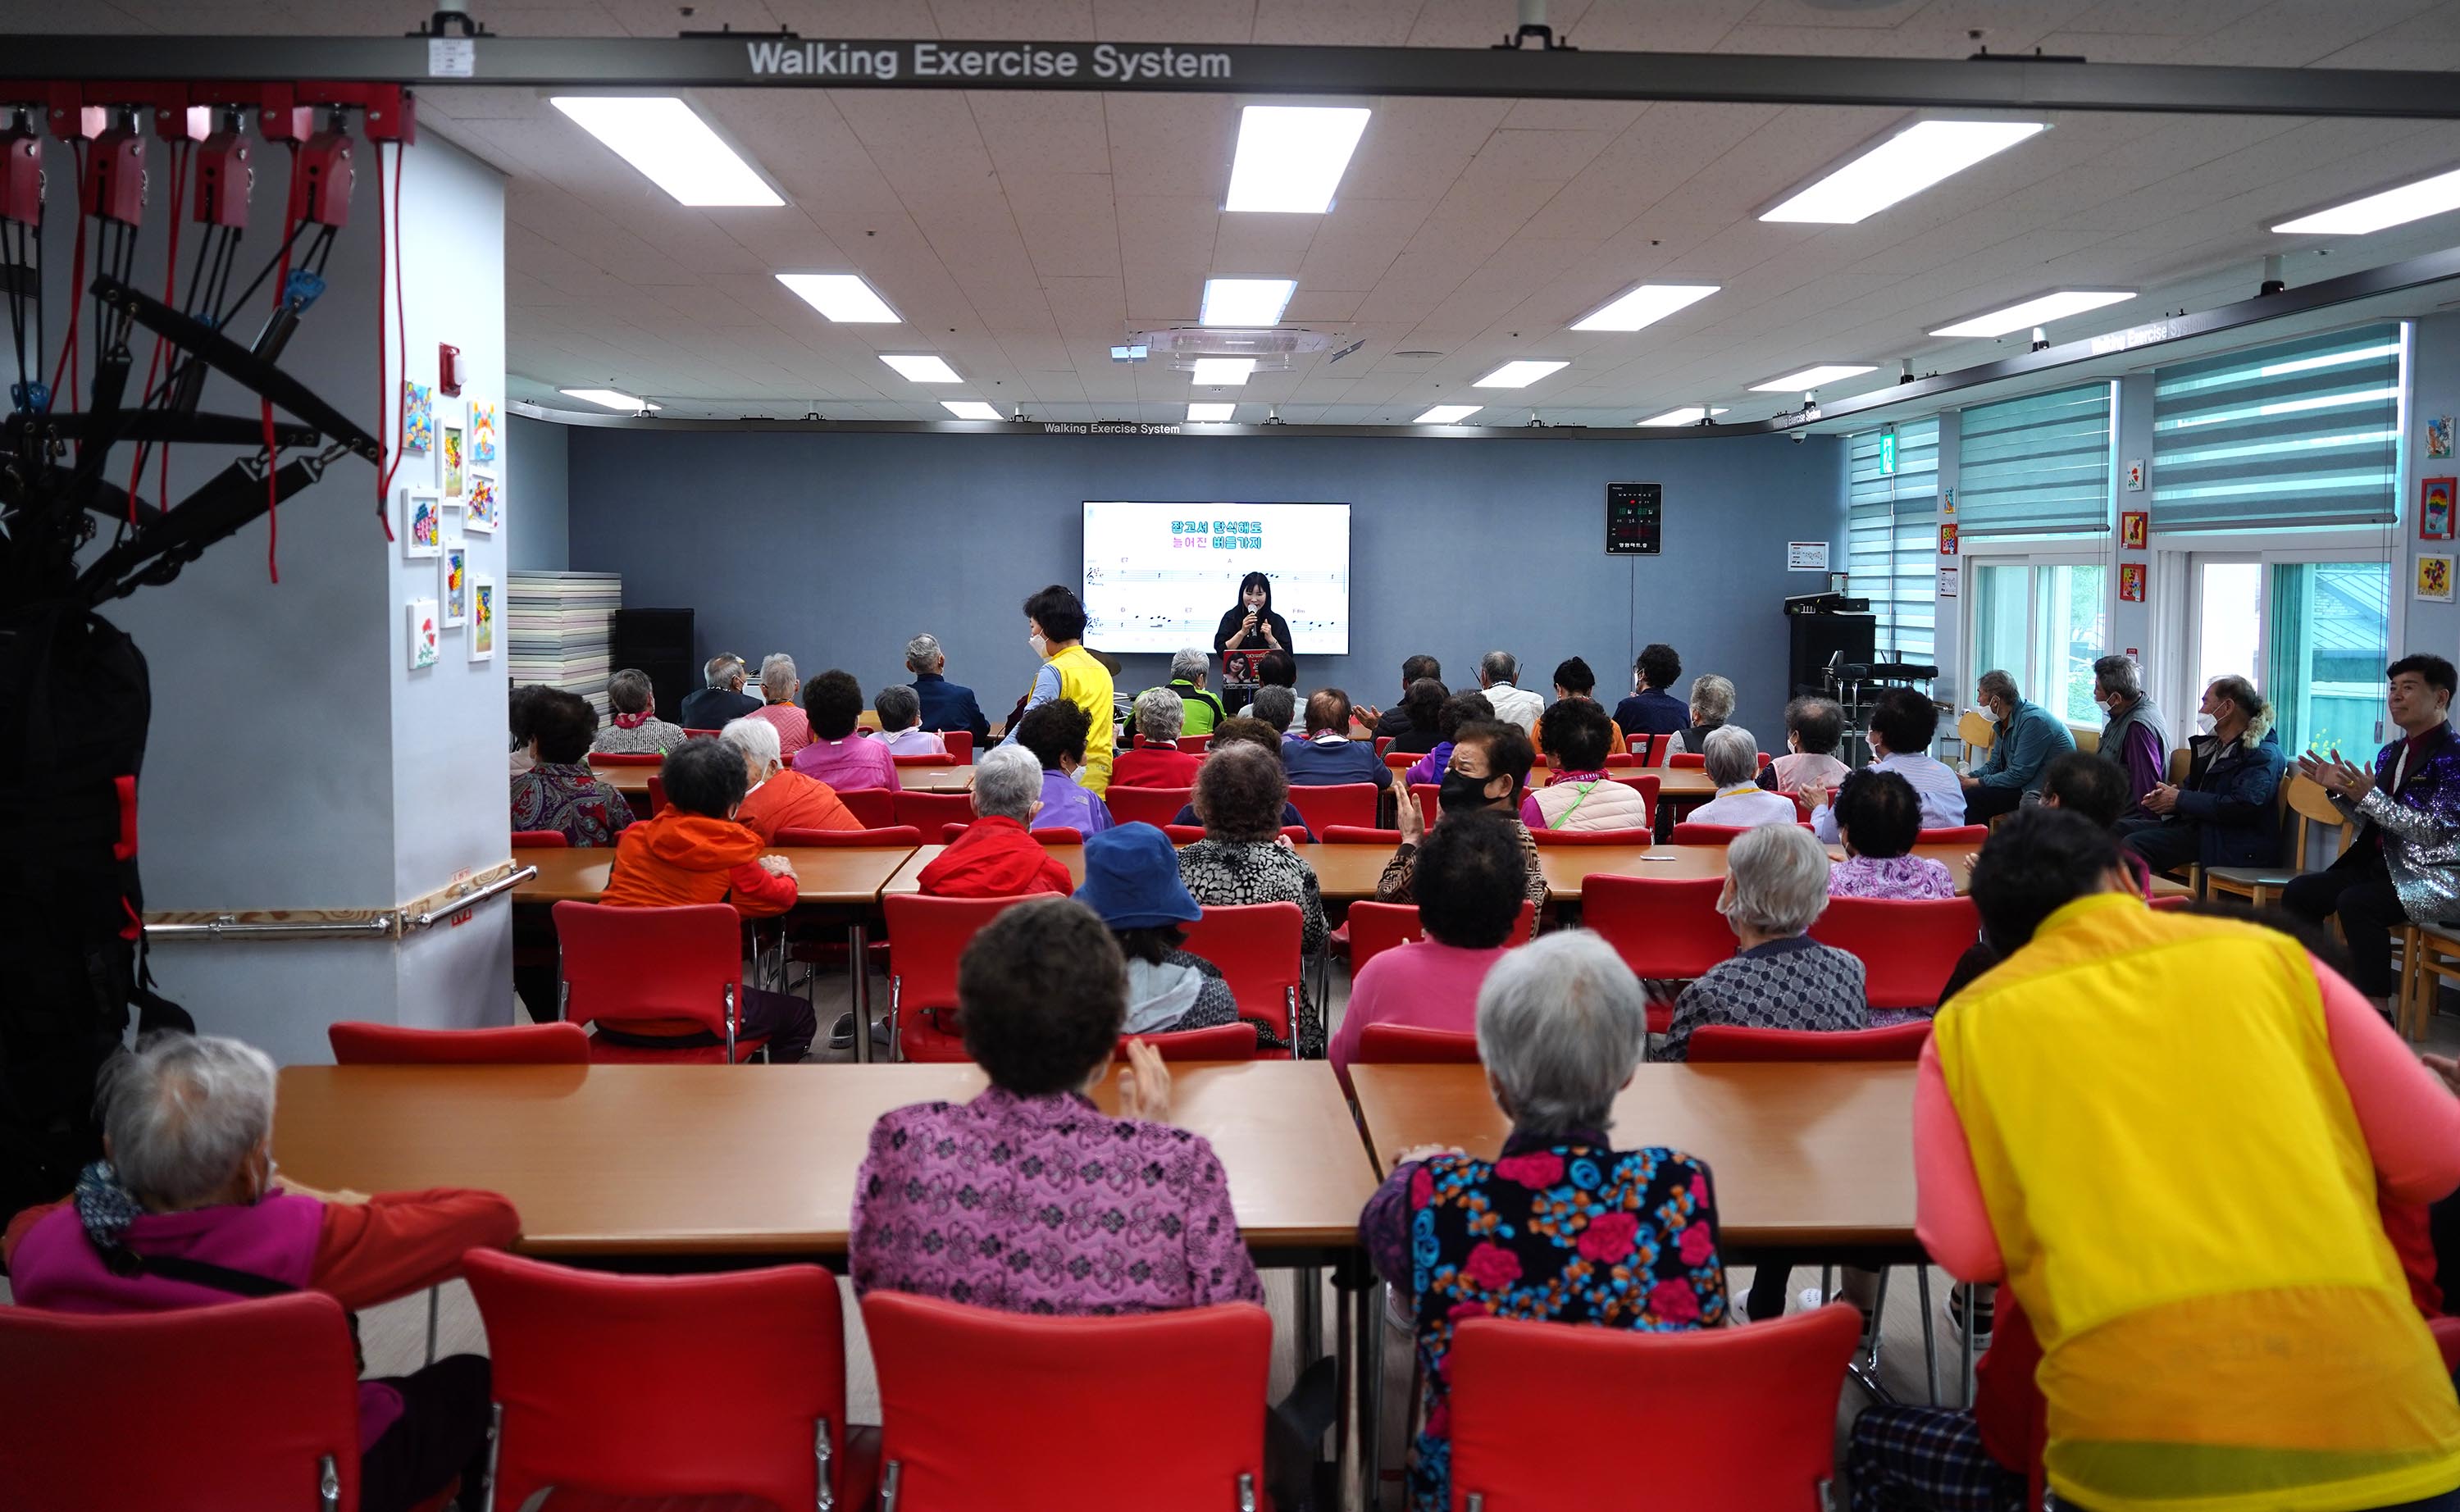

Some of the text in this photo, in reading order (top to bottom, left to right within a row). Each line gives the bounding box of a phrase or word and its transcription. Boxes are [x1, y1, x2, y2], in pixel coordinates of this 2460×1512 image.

[748, 43, 1230, 80] Walking Exercise System
[2128, 325, 2167, 348] Exercise
[1044, 423, 1180, 435] Walking Exercise System
[1214, 521, 1262, 534] 탄식해도
[1173, 535, 1262, 549] 늘어진 버들가지
